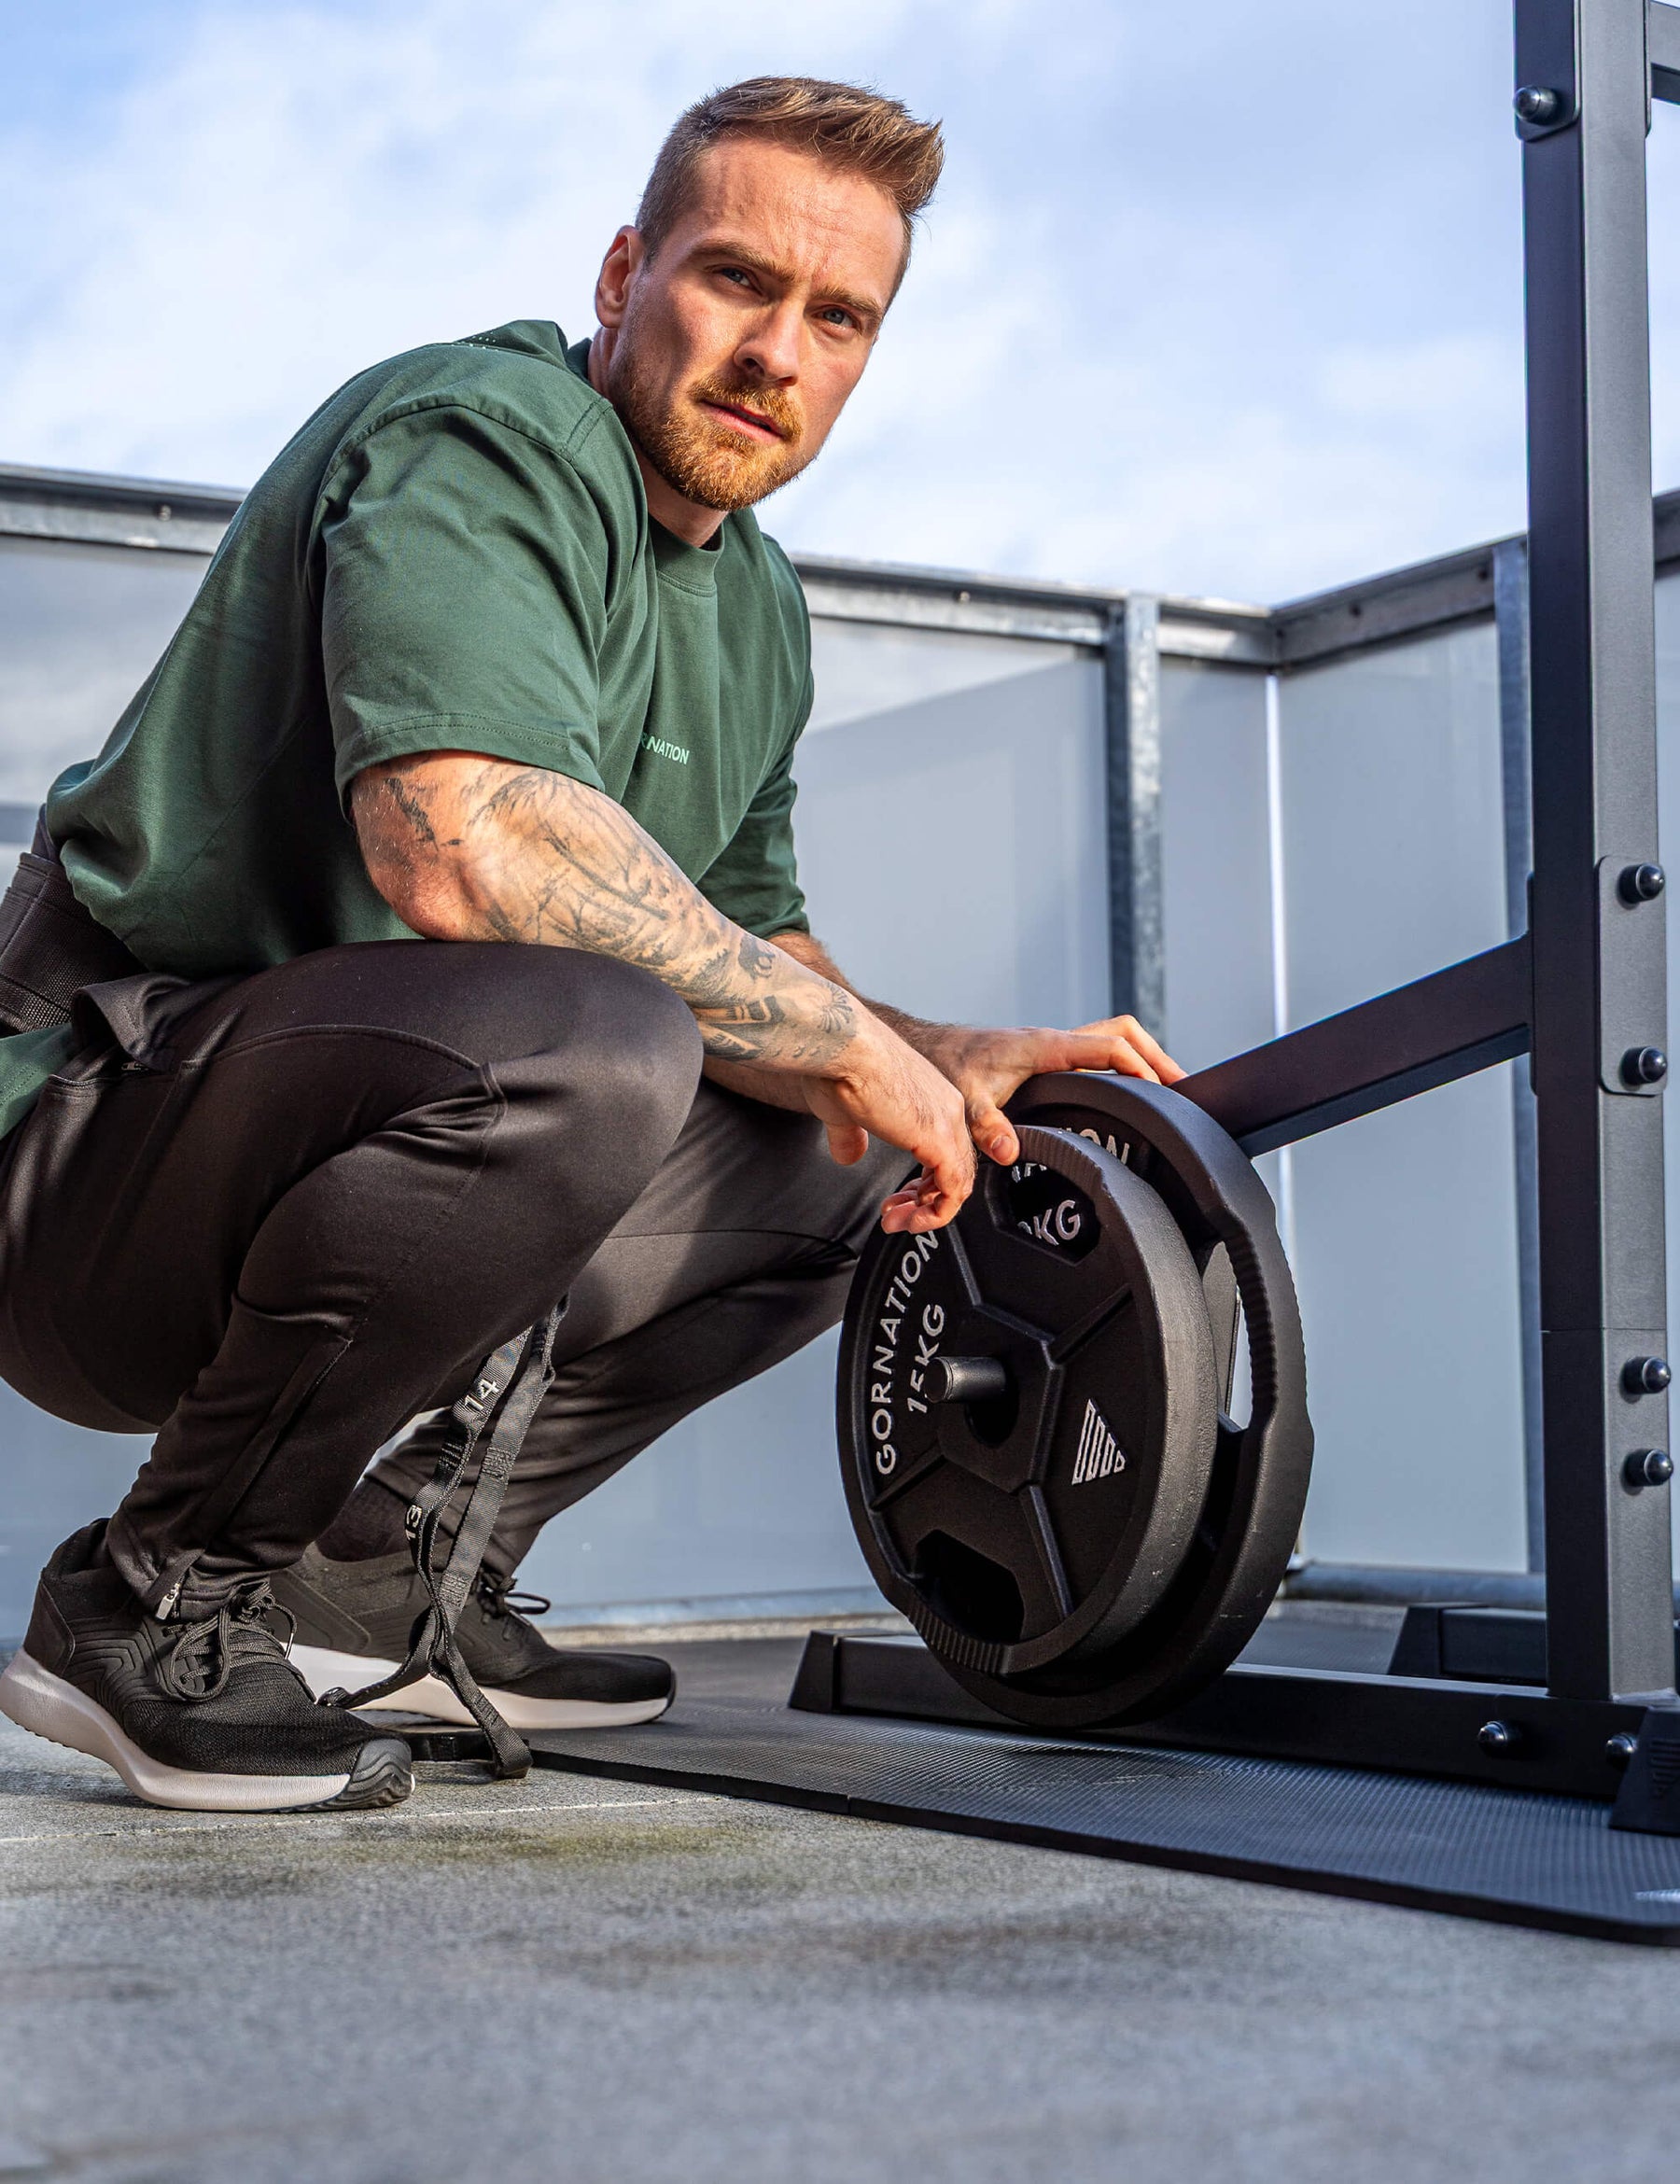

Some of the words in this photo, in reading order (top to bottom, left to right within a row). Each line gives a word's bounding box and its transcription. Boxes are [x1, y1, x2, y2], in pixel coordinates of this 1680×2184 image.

[640, 732, 691, 765] RNATION
[1017, 1199, 1081, 1246] KG
[870, 1230, 940, 1476] GORNATION
[465, 1379, 500, 1411] 14
[405, 1505, 423, 1541] 13
